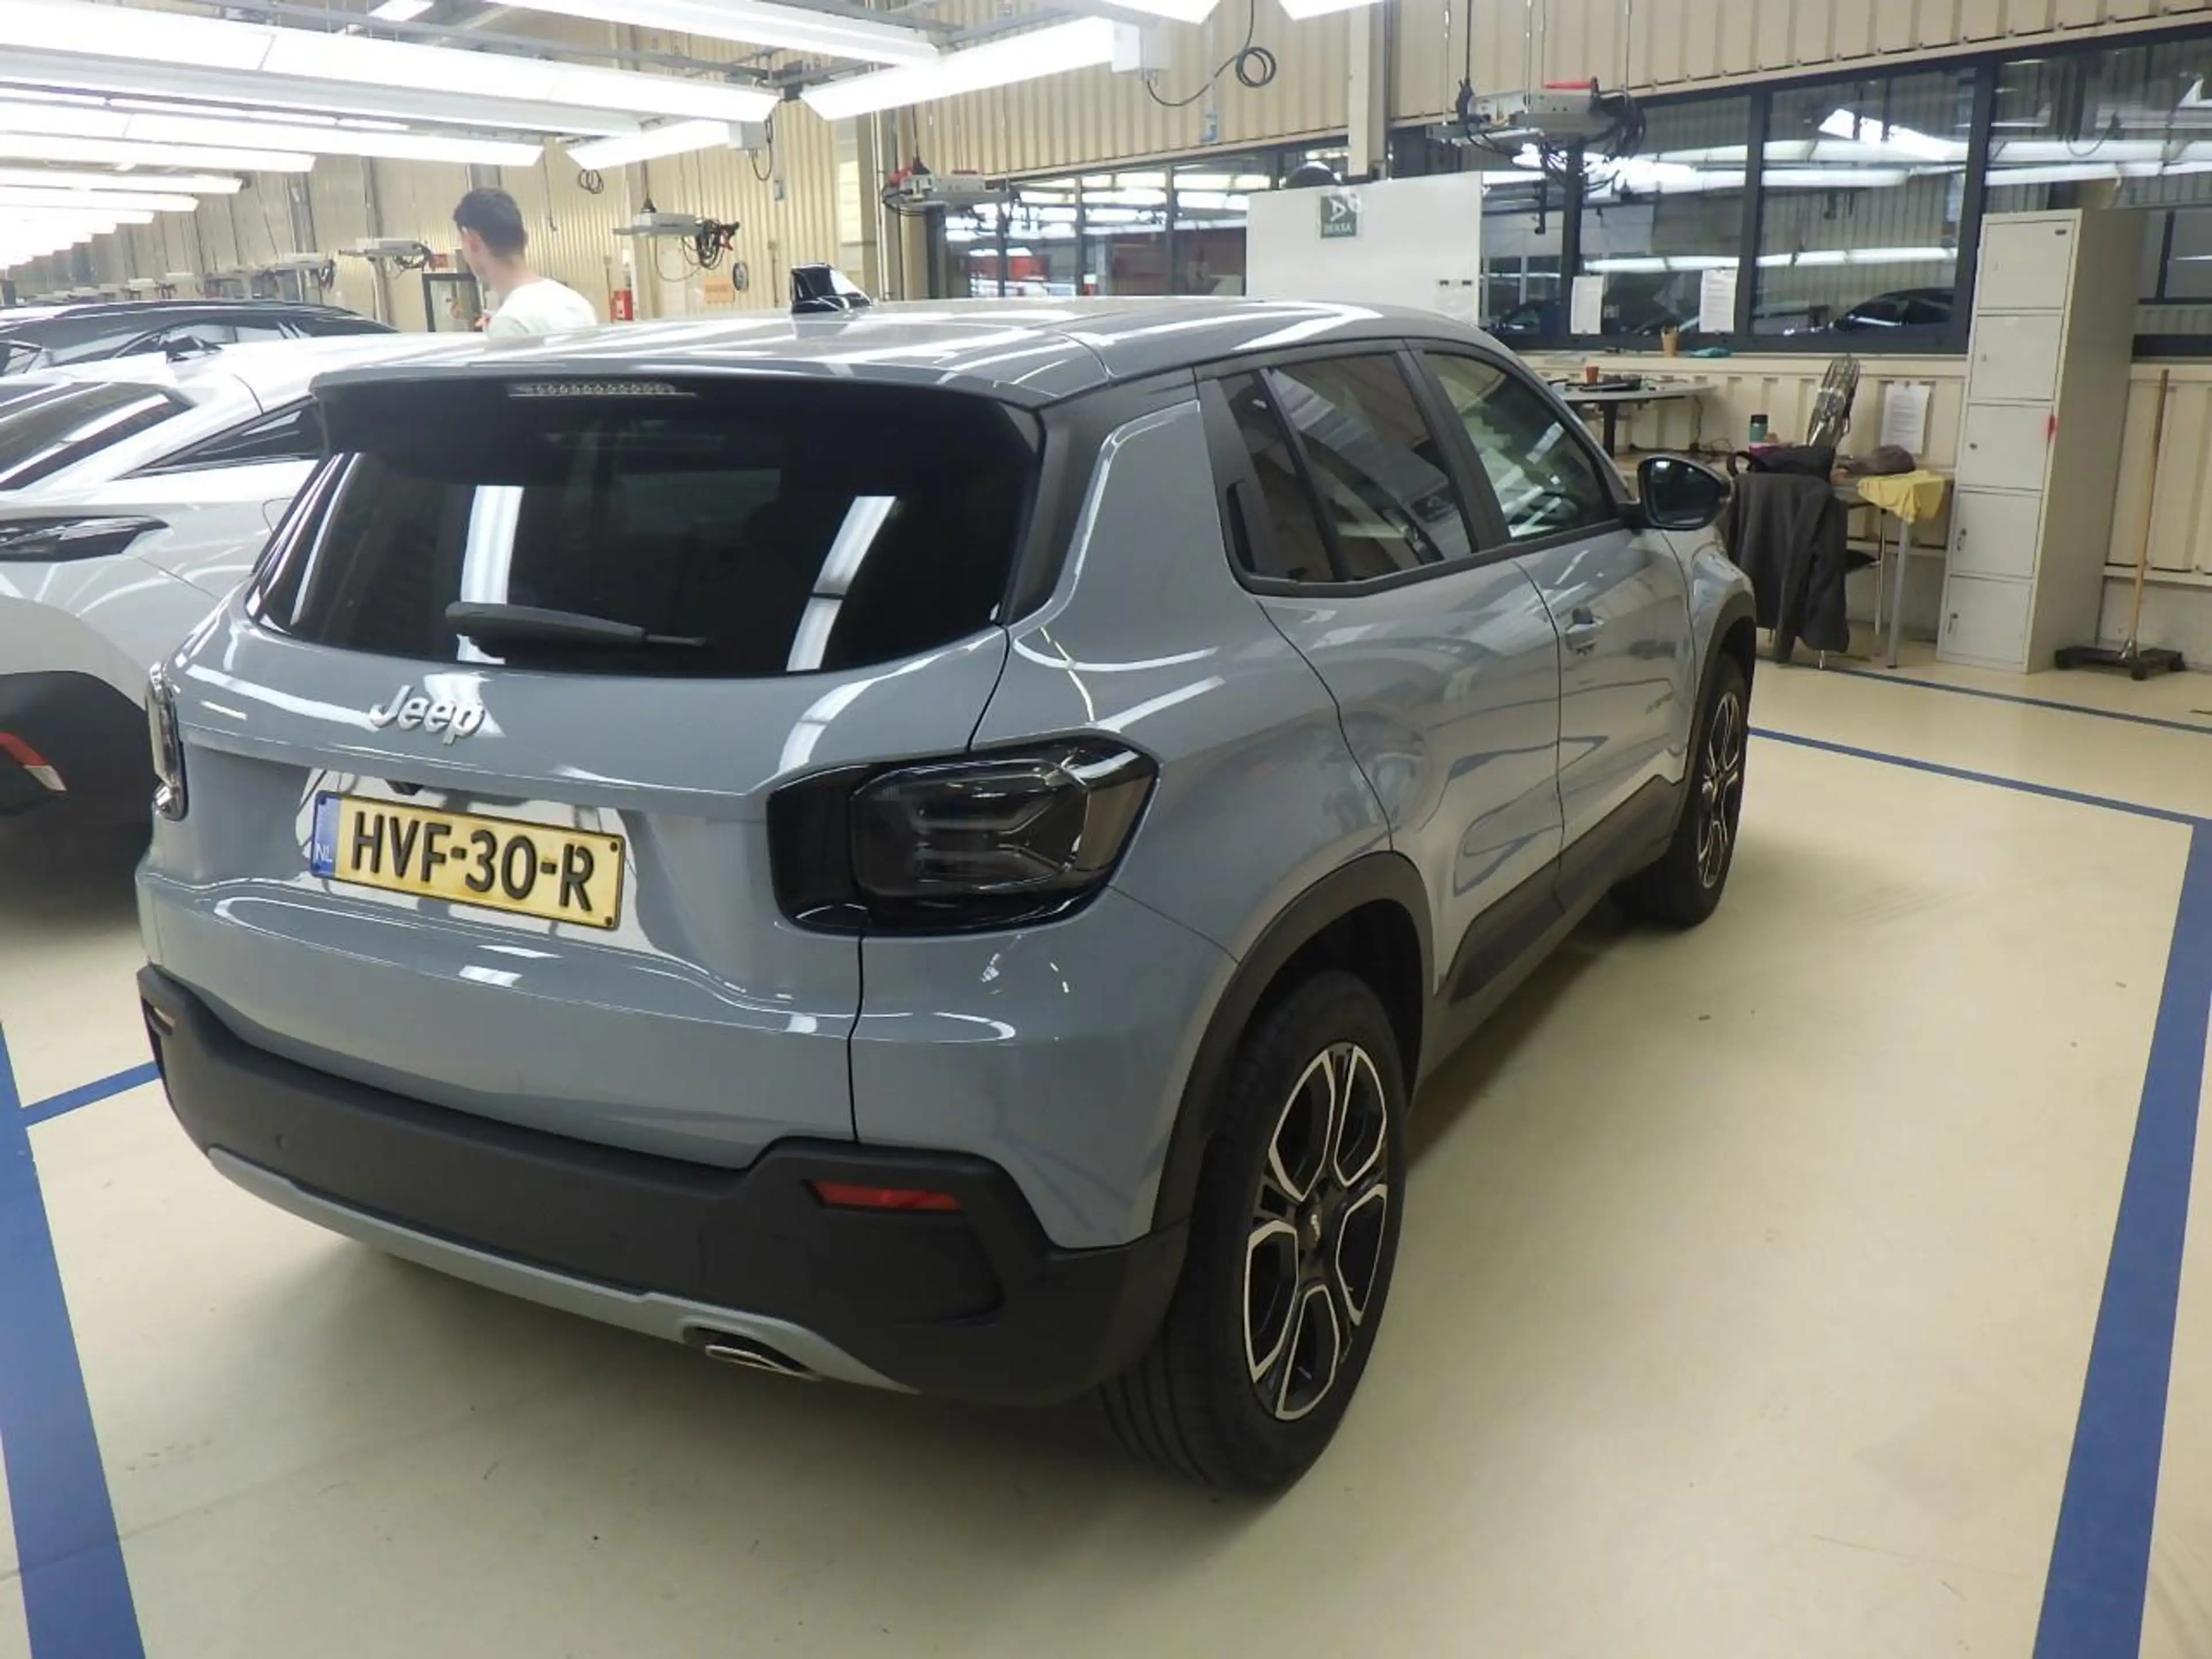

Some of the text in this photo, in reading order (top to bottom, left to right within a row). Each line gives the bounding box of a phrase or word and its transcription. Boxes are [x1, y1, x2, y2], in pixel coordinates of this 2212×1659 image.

[369, 685, 484, 745] Jeep
[314, 843, 332, 863] NL
[351, 811, 594, 912] HVF-30-R
